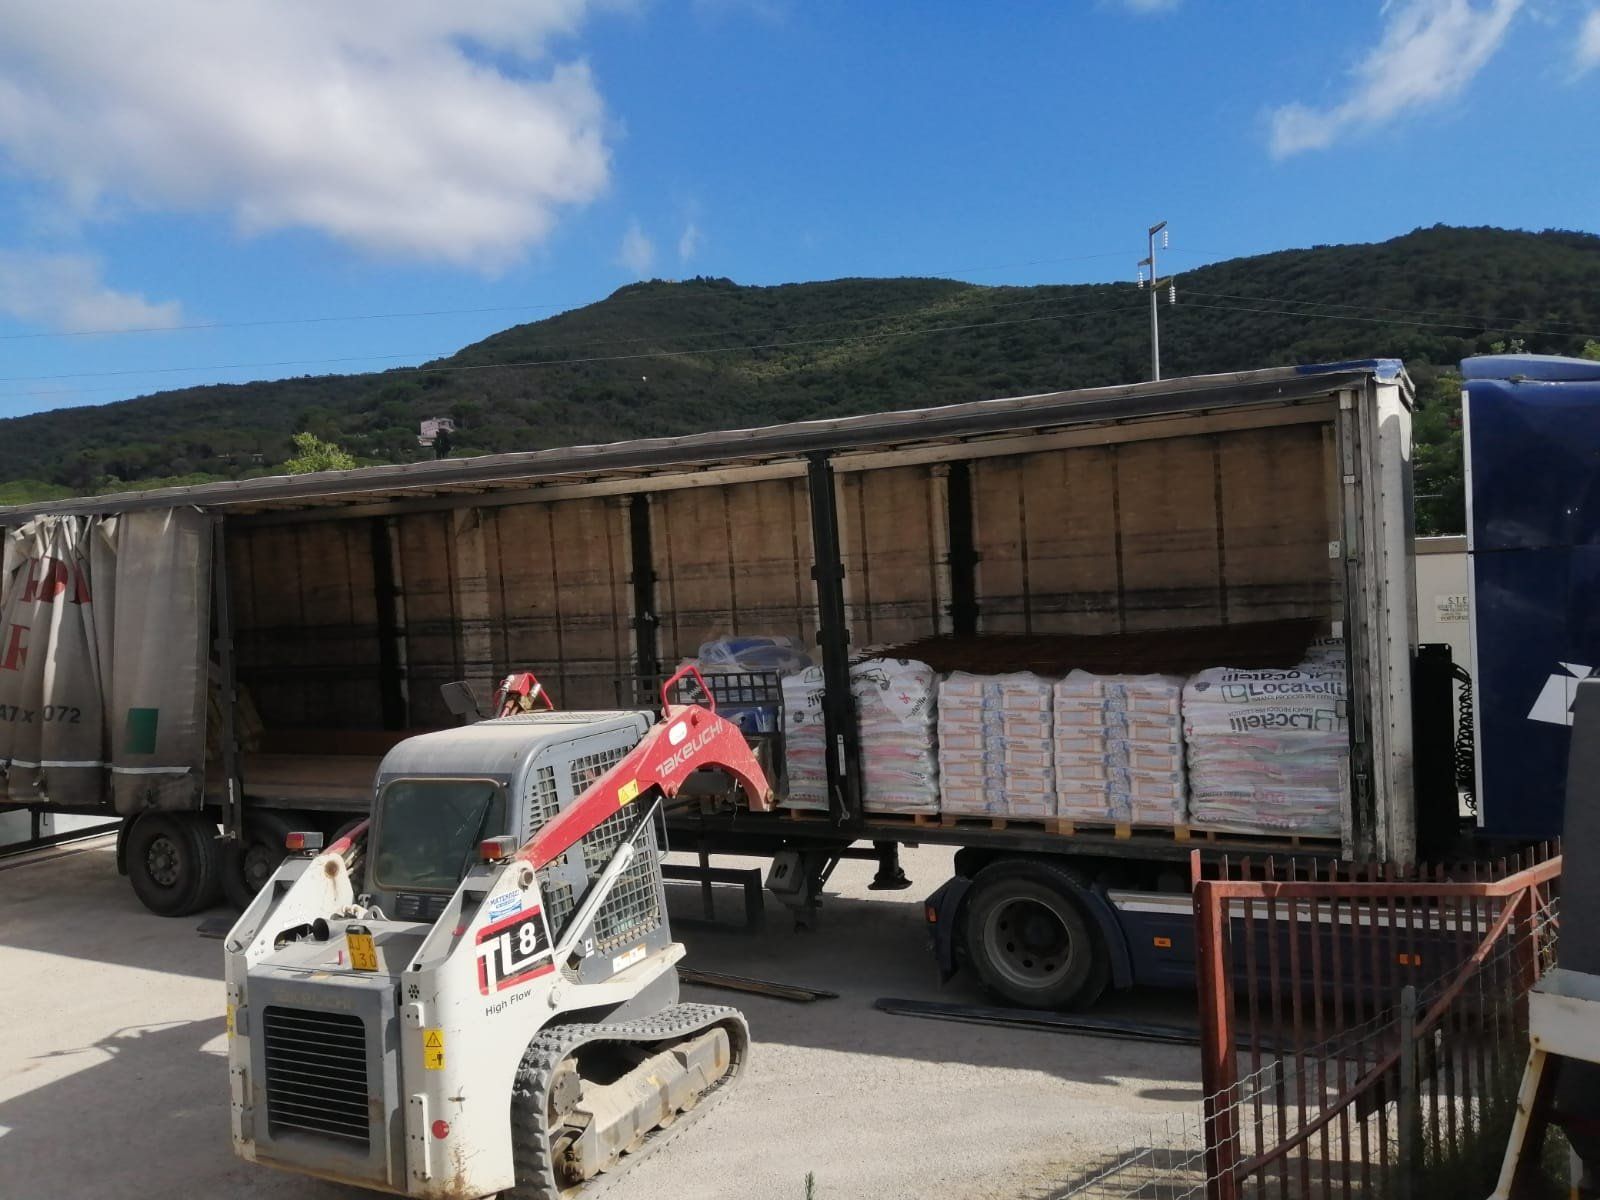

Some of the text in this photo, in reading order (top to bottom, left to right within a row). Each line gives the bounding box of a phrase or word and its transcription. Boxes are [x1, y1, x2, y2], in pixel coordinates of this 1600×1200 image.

[1248, 682, 1344, 697] Locatelli
[1230, 713, 1313, 732] Locatelli
[655, 718, 723, 778] TAKEUCHI
[475, 921, 552, 995] TL8
[485, 988, 532, 1016] High Flow
